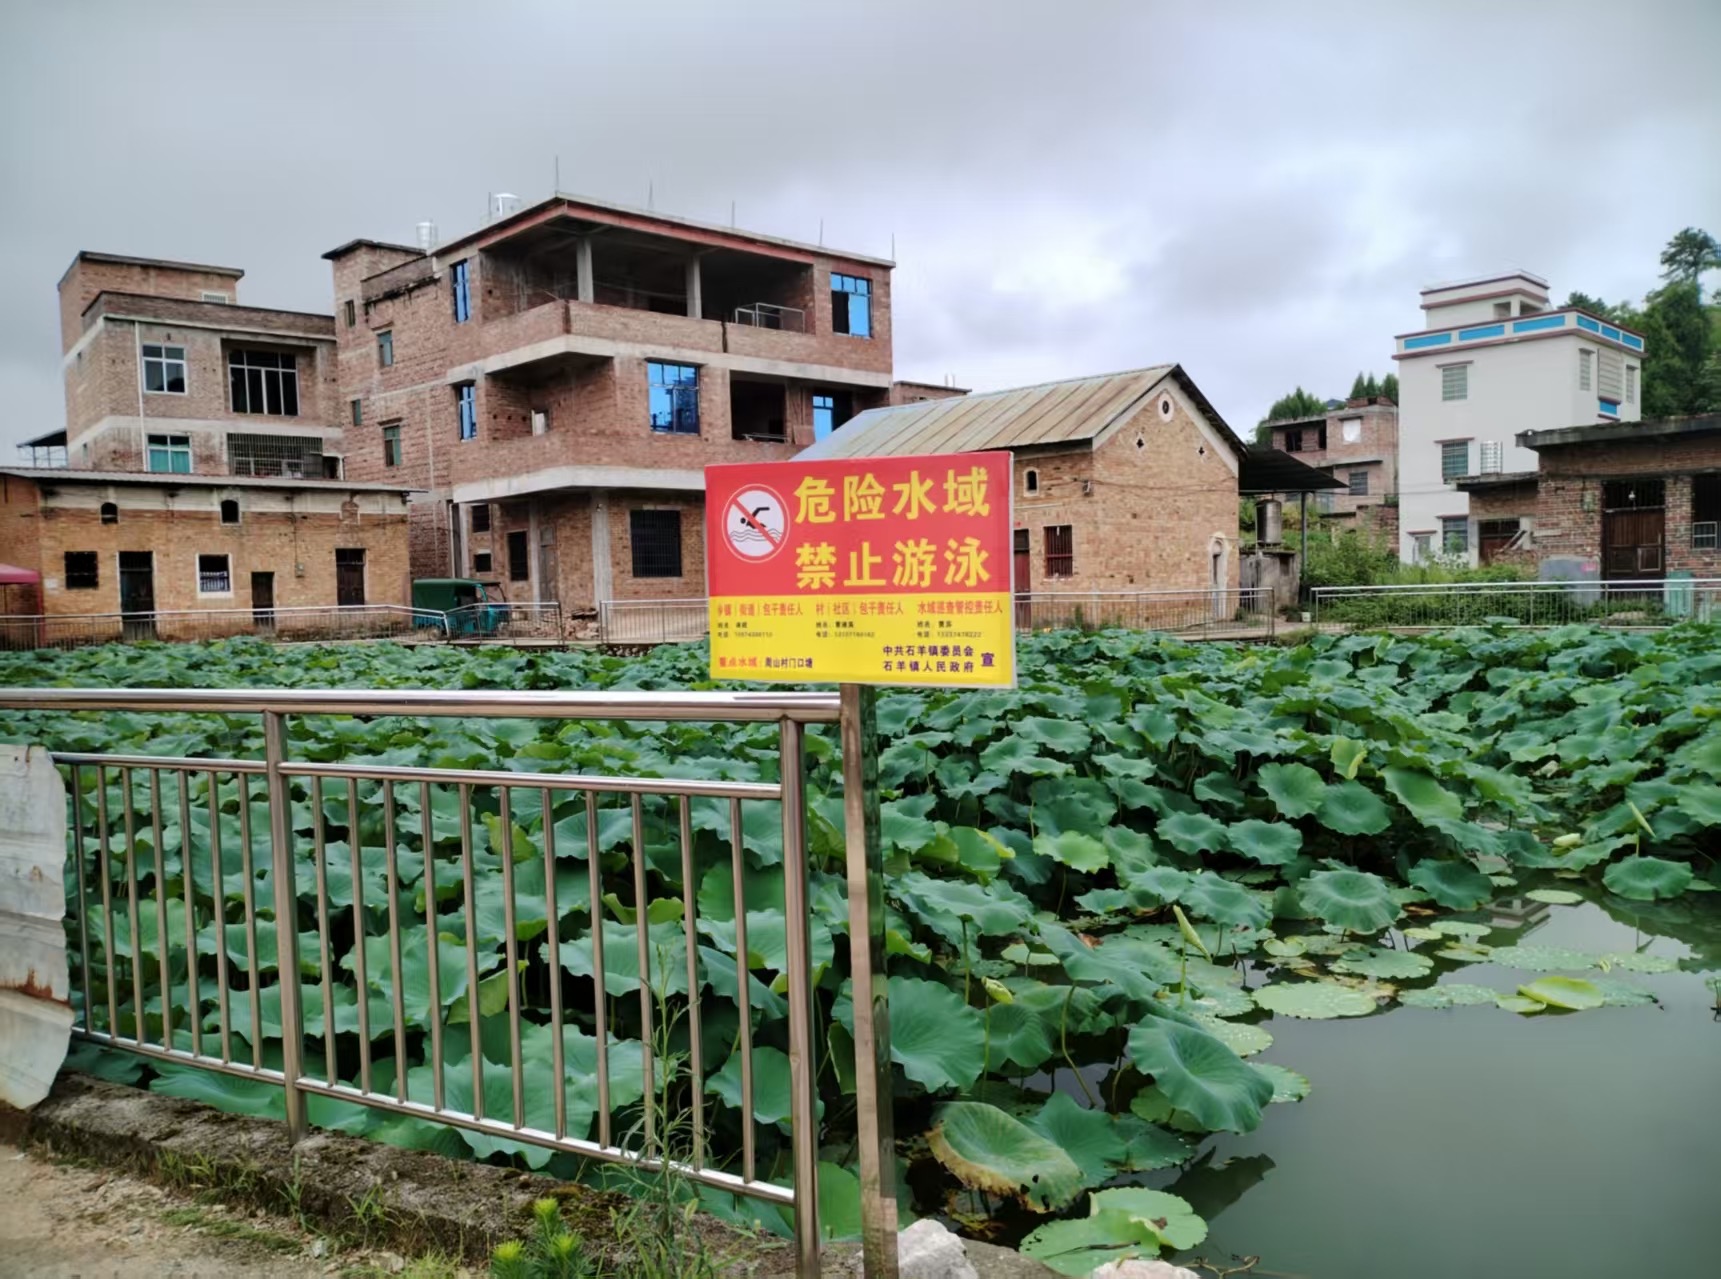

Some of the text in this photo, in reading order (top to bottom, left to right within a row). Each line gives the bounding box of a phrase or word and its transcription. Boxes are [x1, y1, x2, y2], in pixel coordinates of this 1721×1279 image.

[793, 466, 991, 524] 危险水域
[794, 537, 991, 590] 禁止游泳
[883, 645, 974, 657] 中共石羊镇委员会
[883, 660, 974, 673] 石羊镇人民政府
[980, 652, 995, 667] 宣
